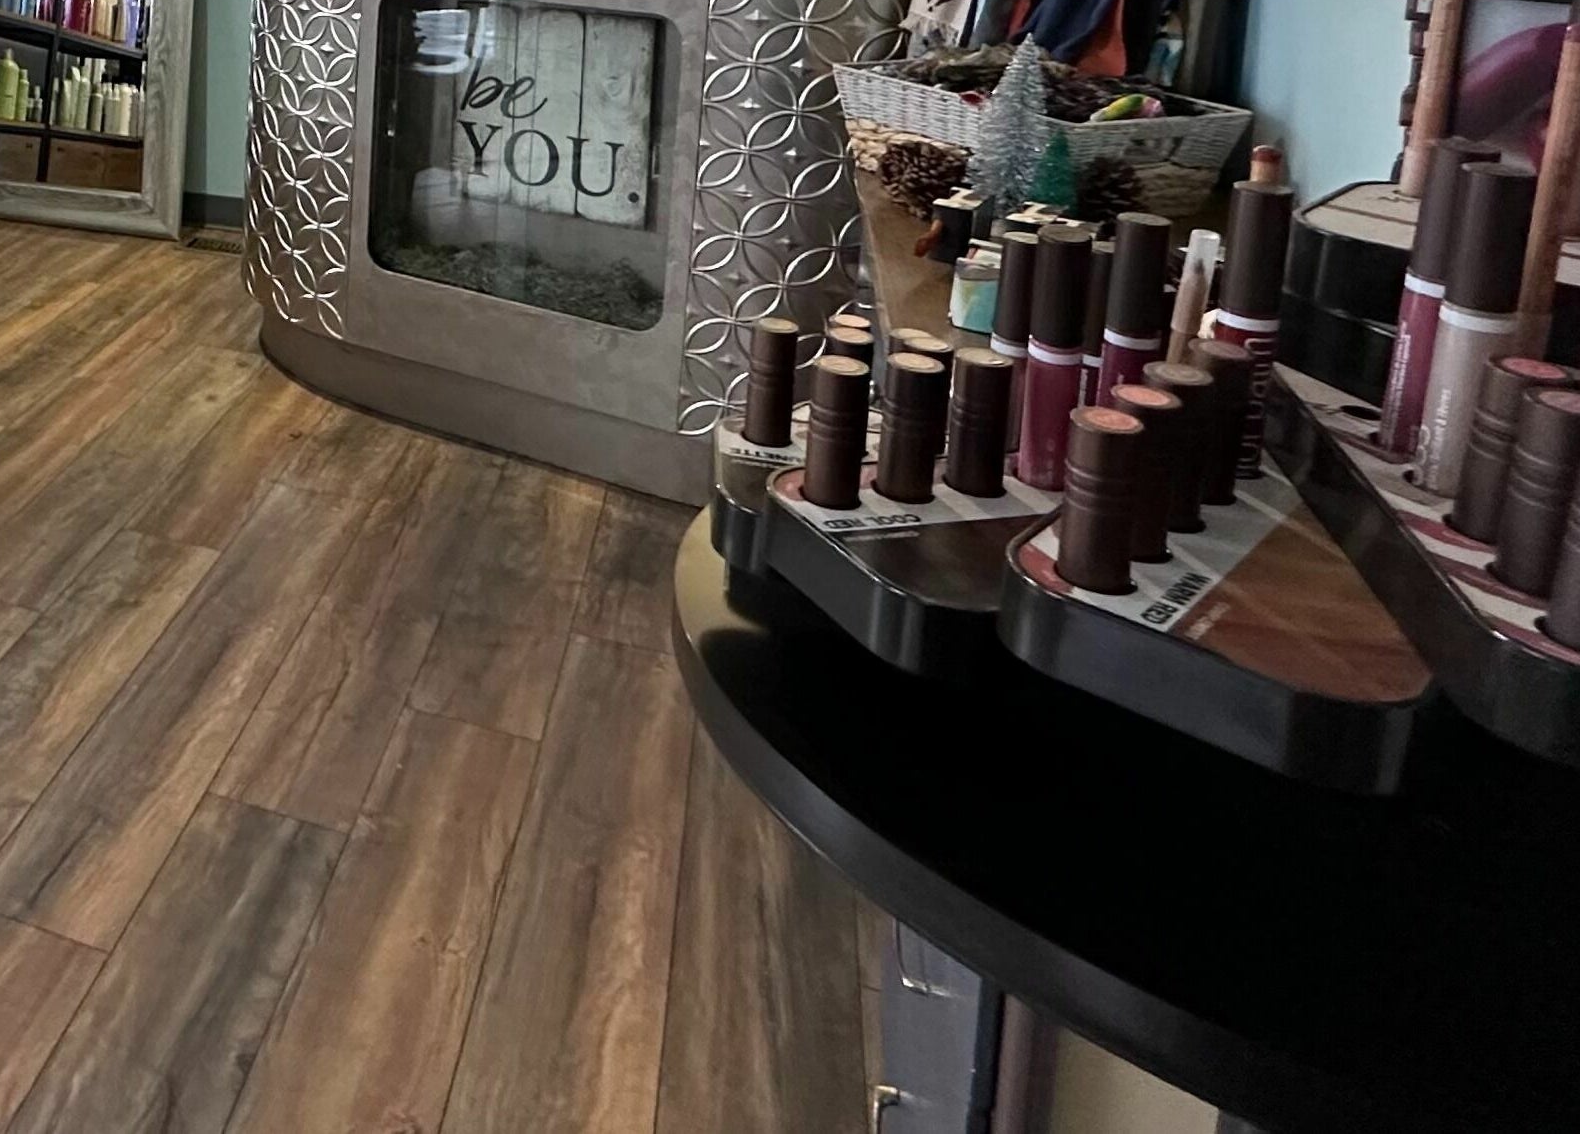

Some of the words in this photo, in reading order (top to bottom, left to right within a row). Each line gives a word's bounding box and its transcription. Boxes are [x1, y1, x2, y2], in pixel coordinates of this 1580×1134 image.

[459, 52, 548, 119] be
[457, 120, 640, 204] YOU.
[729, 447, 803, 463] UNETTE
[824, 518, 865, 529] RED
[866, 513, 922, 526] COOL
[1161, 572, 1212, 606] WARM
[1140, 601, 1179, 624] RED
